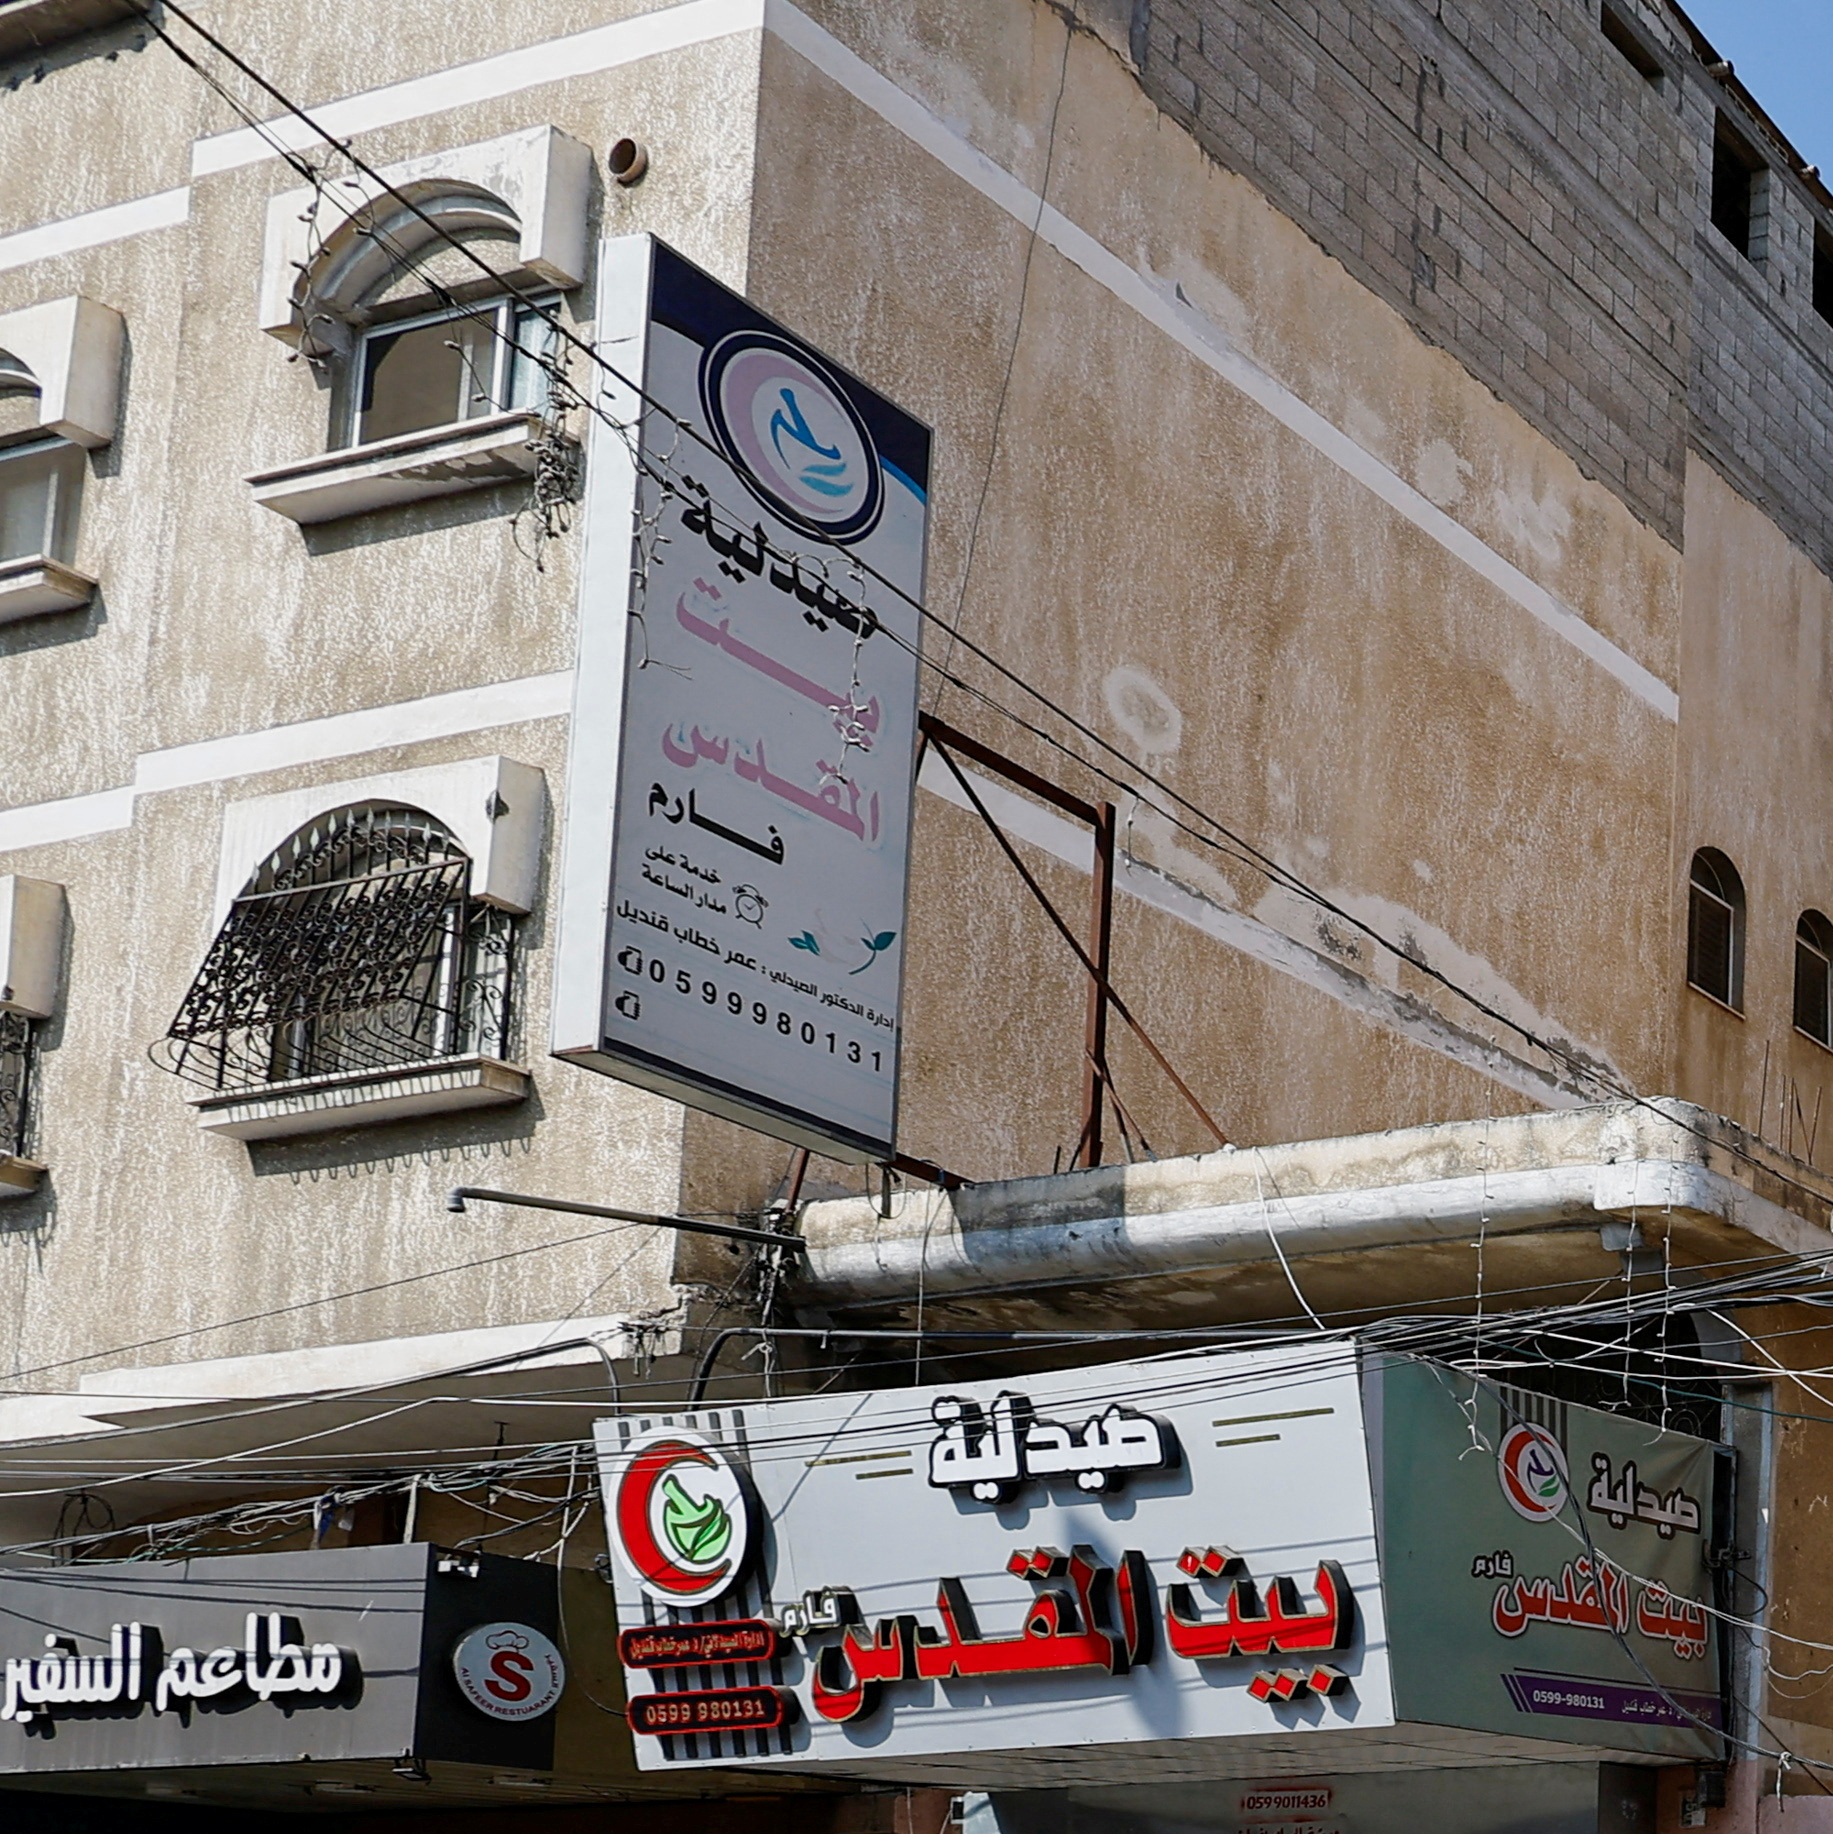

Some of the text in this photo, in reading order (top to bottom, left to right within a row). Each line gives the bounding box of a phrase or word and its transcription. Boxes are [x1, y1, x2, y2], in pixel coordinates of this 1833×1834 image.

[681, 475, 879, 639] صيدلية
[676, 577, 880, 747] بيت
[662, 723, 879, 842] المقدس
[649, 782, 785, 865] فارم
[641, 863, 727, 916] مدار الساعة
[645, 846, 721, 884] خدمة على
[616, 900, 669, 934] قنديل
[674, 926, 720, 955] خطاب
[724, 949, 757, 971] عمر
[820, 990, 864, 1017] الدكتور
[928, 1393, 1170, 1504] صيدلية
[1588, 1453, 1700, 1538] صيدلية
[780, 1545, 1352, 1722] بيت المقدس فارم
[1473, 1553, 1708, 1658] بيت المقدس فارم
[1, 1612, 341, 1723] مطاعم السفير
[484, 1651, 534, 1702] S
[1532, 1689, 1605, 1710] 0599-980131
[646, 1699, 766, 1725] 0599 980131
